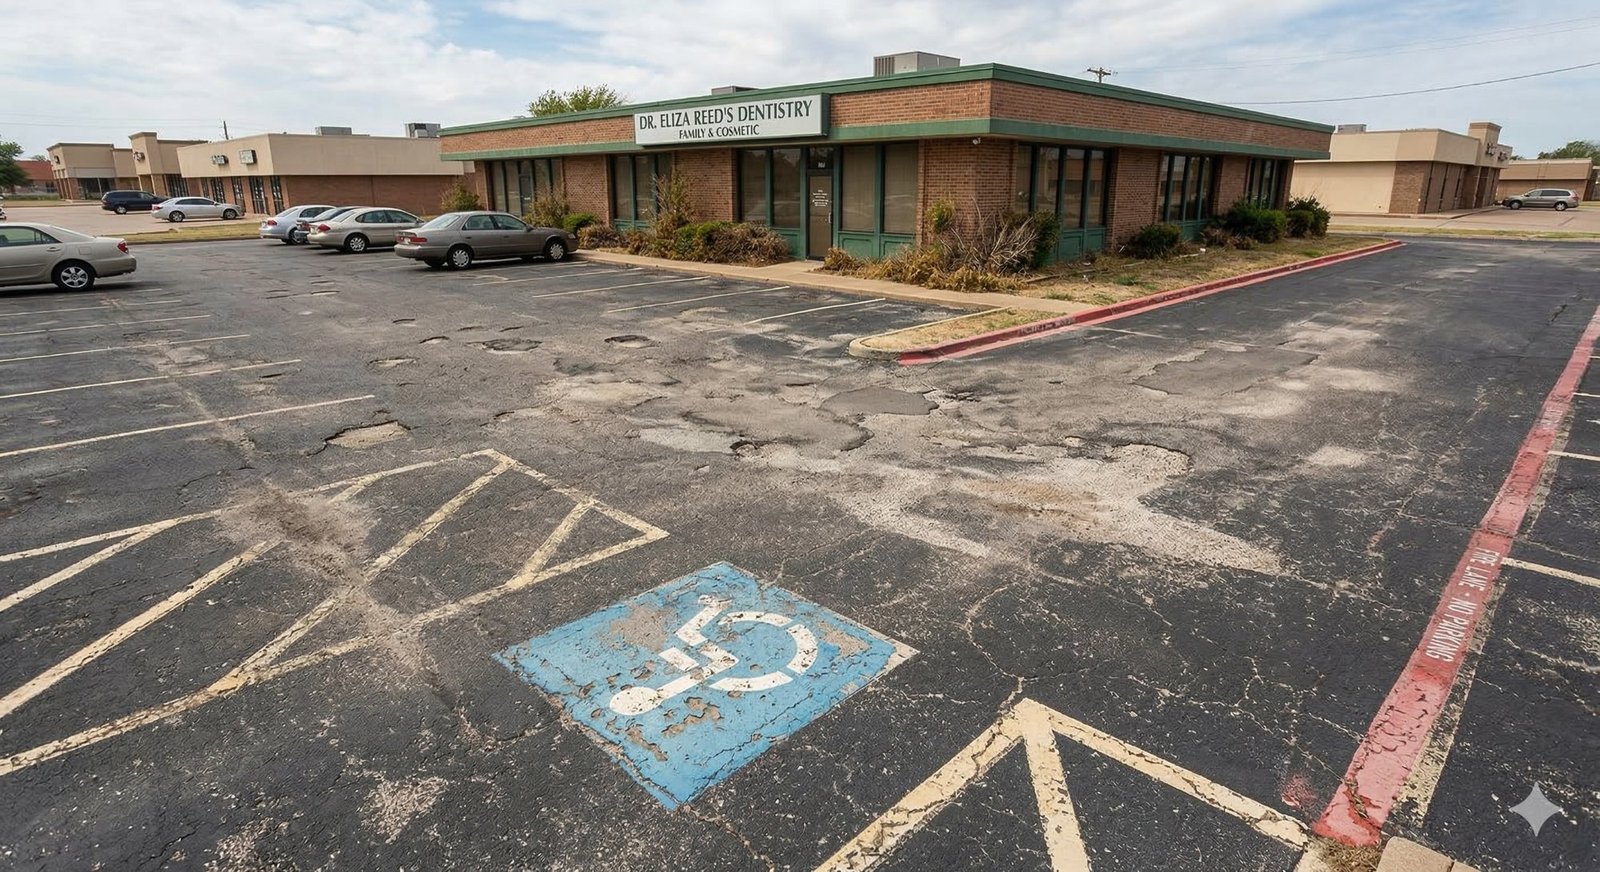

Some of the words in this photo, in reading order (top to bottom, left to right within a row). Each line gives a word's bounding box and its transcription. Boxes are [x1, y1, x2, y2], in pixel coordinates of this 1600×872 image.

[639, 114, 657, 130] DR.
[660, 111, 690, 128] ELIZA
[694, 106, 734, 125] REED'S
[738, 100, 813, 122] DENTISTRY
[678, 127, 706, 140] FAMILY
[707, 127, 714, 137] &
[716, 123, 760, 137] COSMETIC
[1458, 566, 1491, 591] LANE
[1448, 597, 1478, 615] NO
[1425, 613, 1469, 662] PARKING
